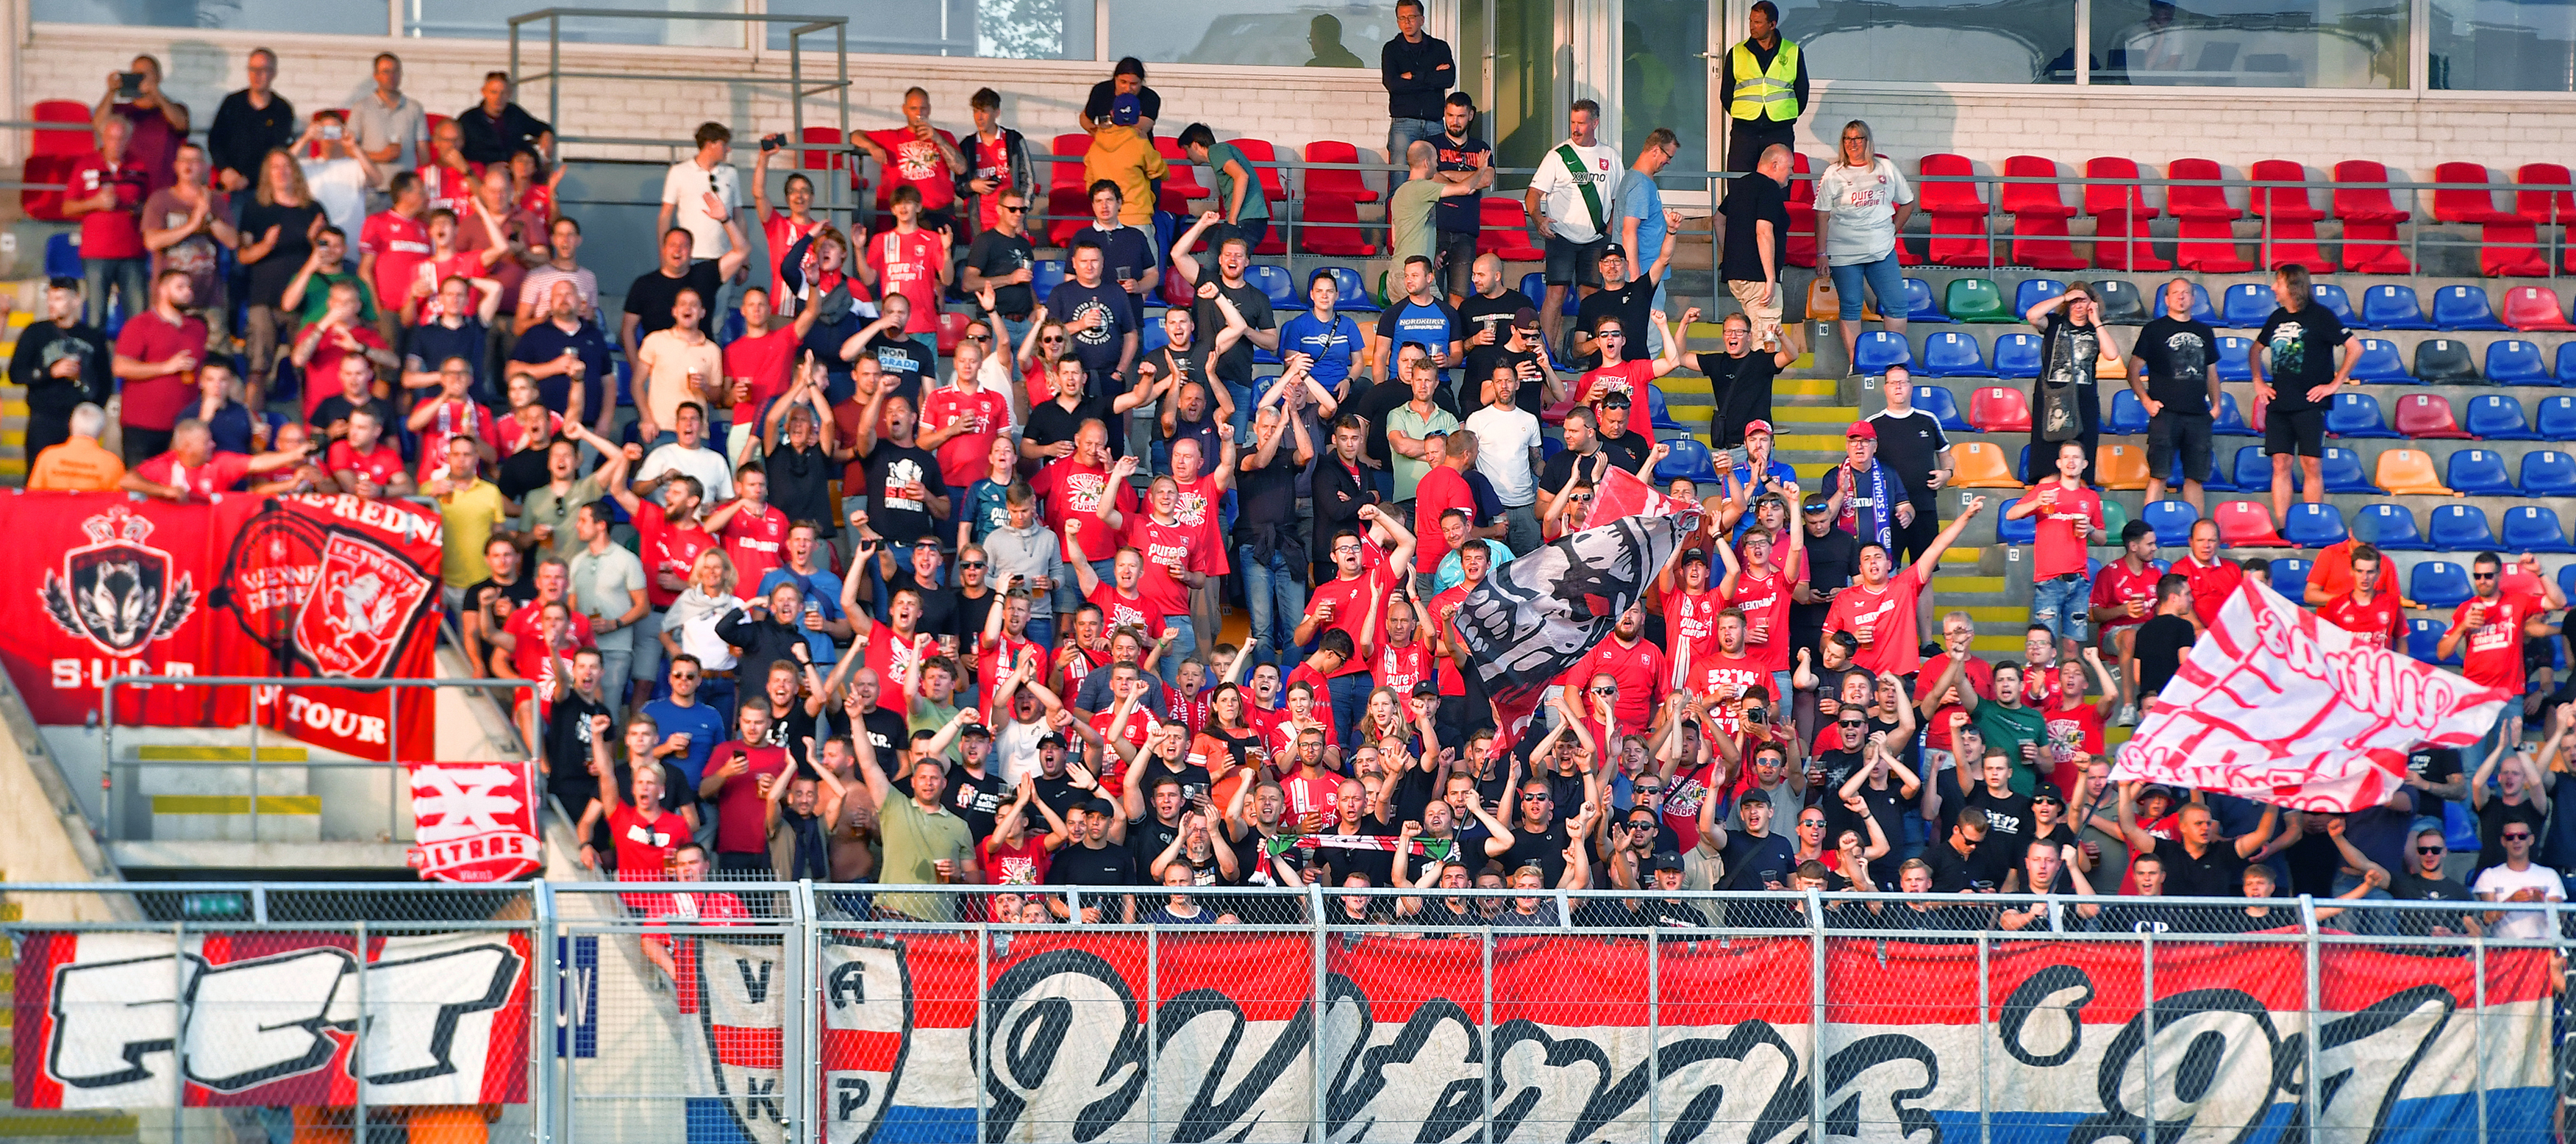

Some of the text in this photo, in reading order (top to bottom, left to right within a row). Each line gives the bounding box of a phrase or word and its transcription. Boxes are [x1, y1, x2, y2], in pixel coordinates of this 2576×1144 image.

[1851, 190, 1874, 205] pure
[1855, 199, 1880, 208] energie
[887, 262, 910, 274] pure
[1399, 318, 1445, 326] NORDKURVE
[1820, 326, 1827, 334] 16
[881, 348, 905, 359] NON
[1866, 379, 1874, 387] 15
[1872, 469, 1885, 509] SCHALKE
[1964, 495, 1972, 503] 13
[1877, 510, 1887, 523] FC
[1680, 618, 1702, 631] pure
[1682, 628, 1707, 639] energie
[1386, 673, 1409, 686] pure
[285, 695, 385, 745] TOUR
